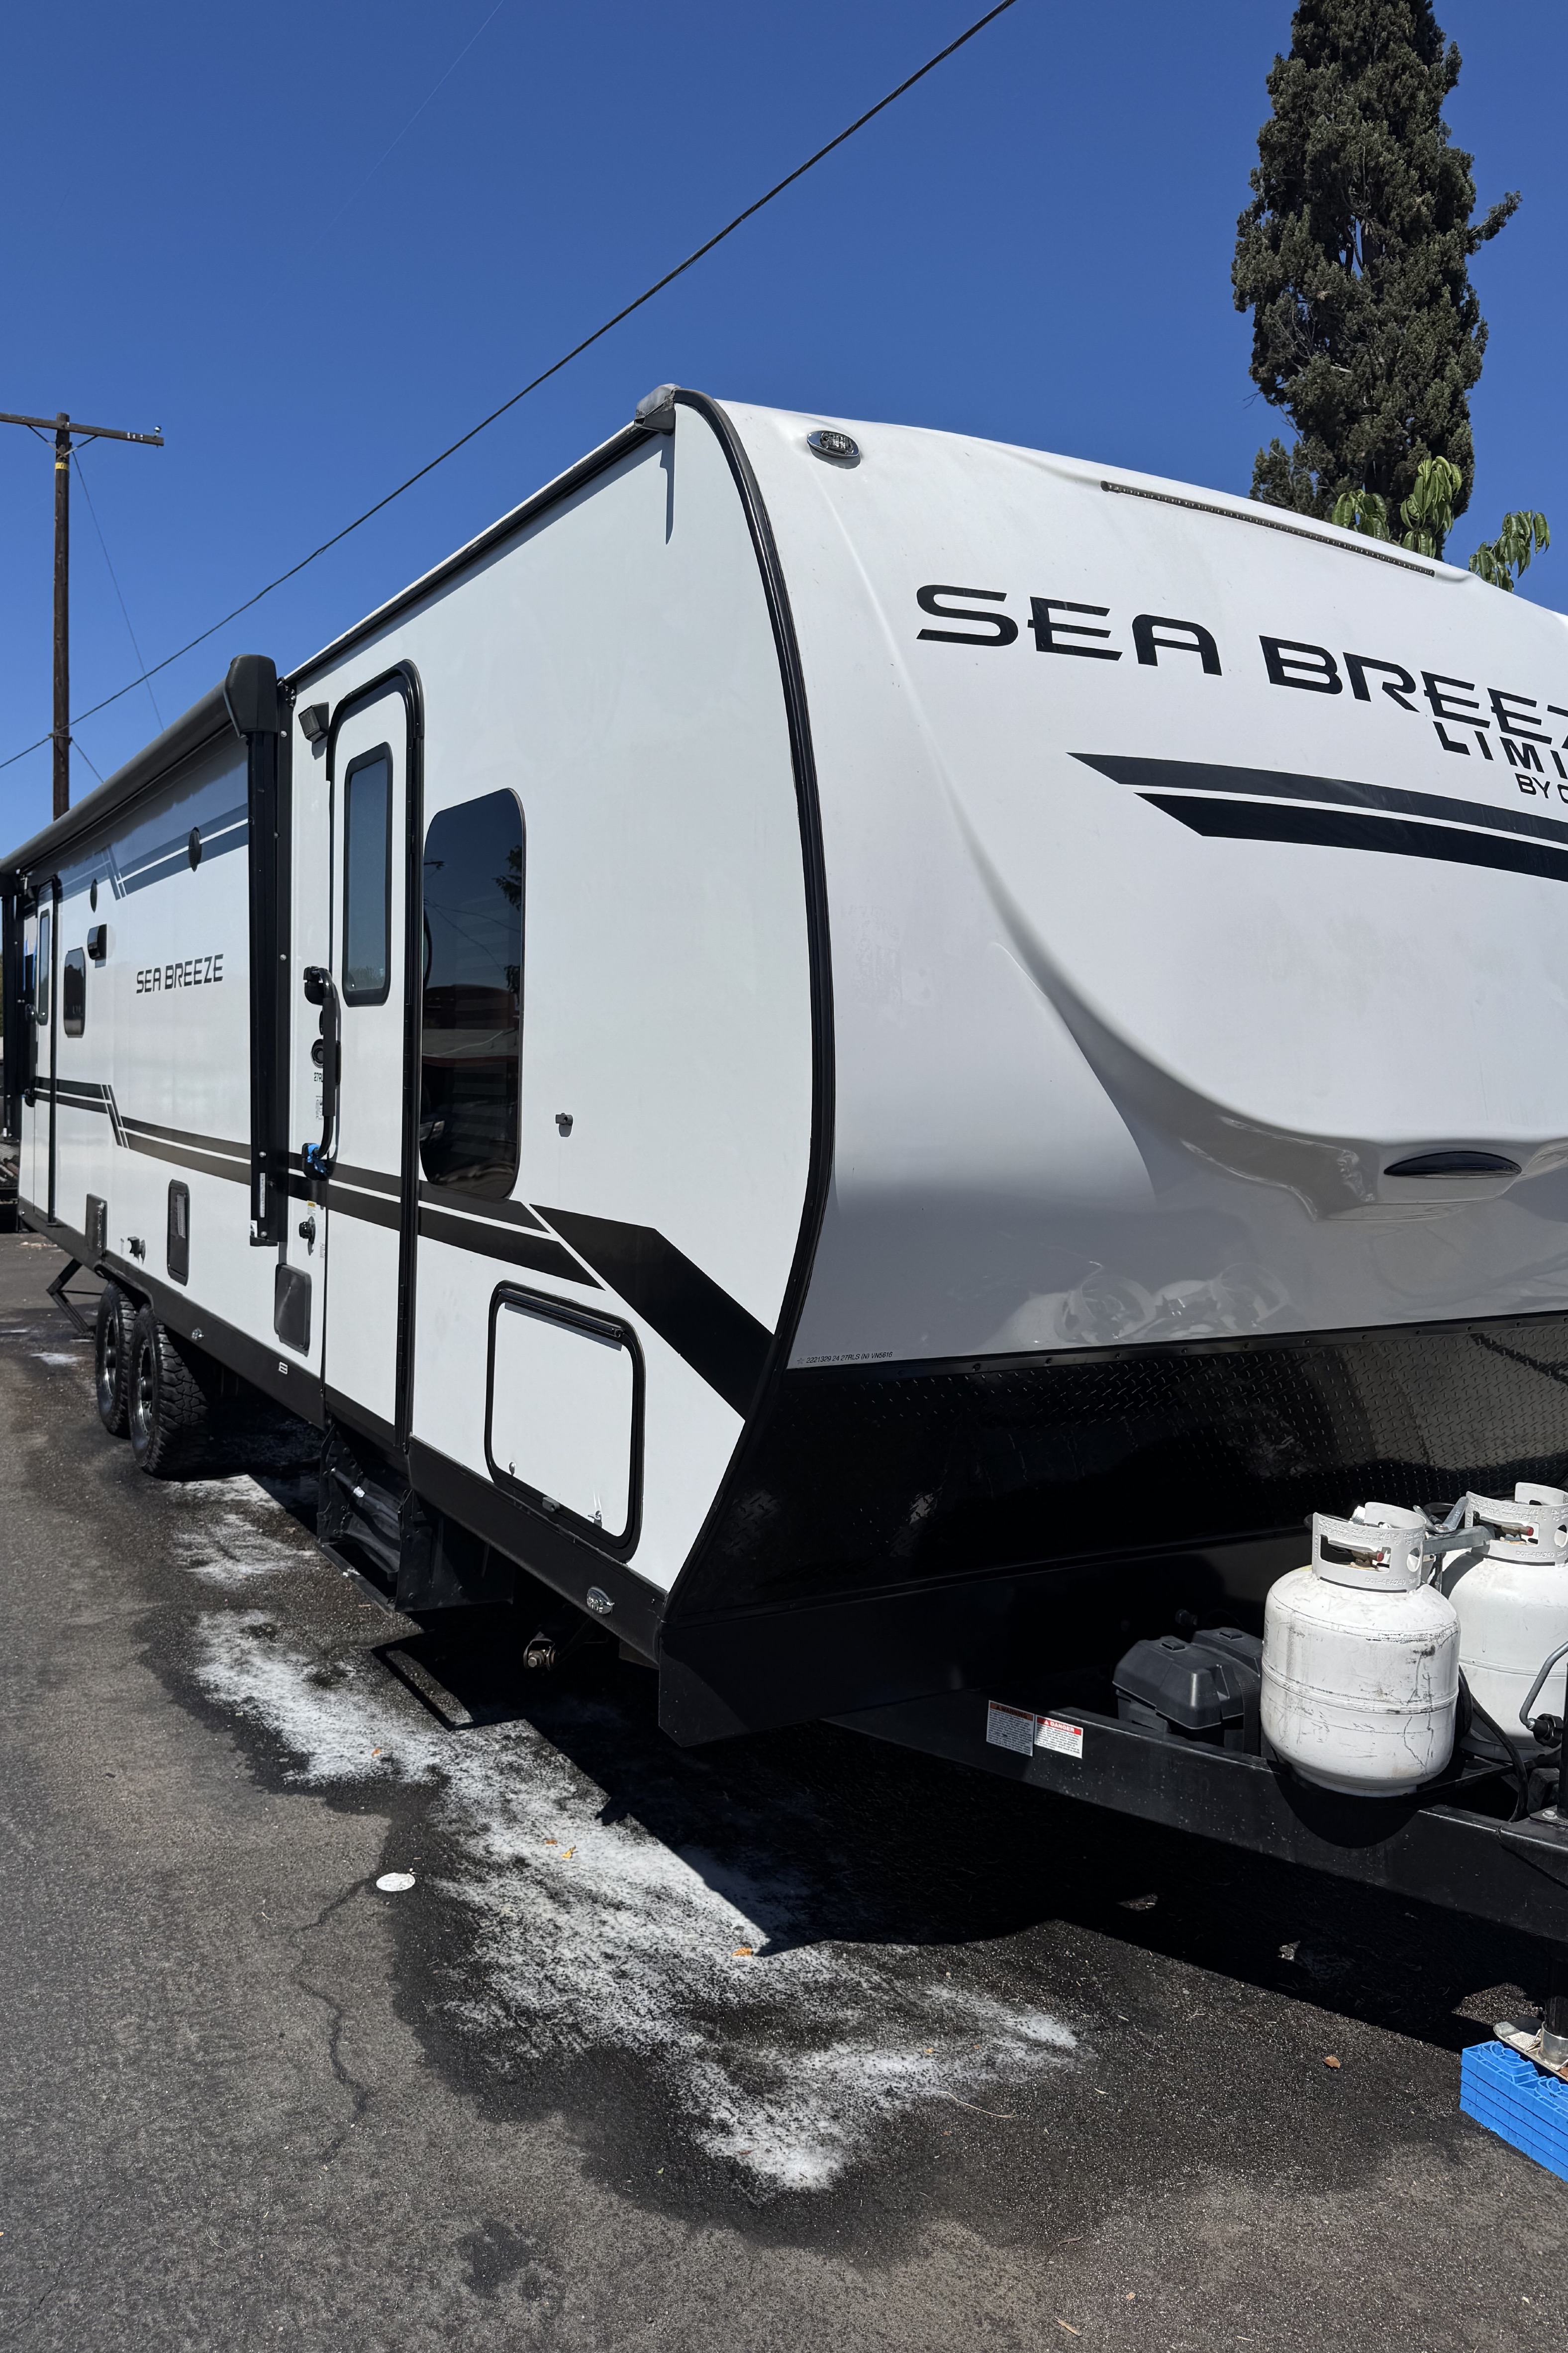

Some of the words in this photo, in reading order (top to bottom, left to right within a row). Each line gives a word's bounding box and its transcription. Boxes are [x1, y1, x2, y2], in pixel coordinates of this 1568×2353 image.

[916, 584, 1222, 676] SEA
[1432, 720, 1568, 780] LIMI
[1514, 772, 1551, 799] BY
[136, 967, 161, 994] SEA
[165, 953, 224, 990] BREEZE
[313, 1072, 323, 1083] 27RL
[1050, 1721, 1075, 1734] DANGER
